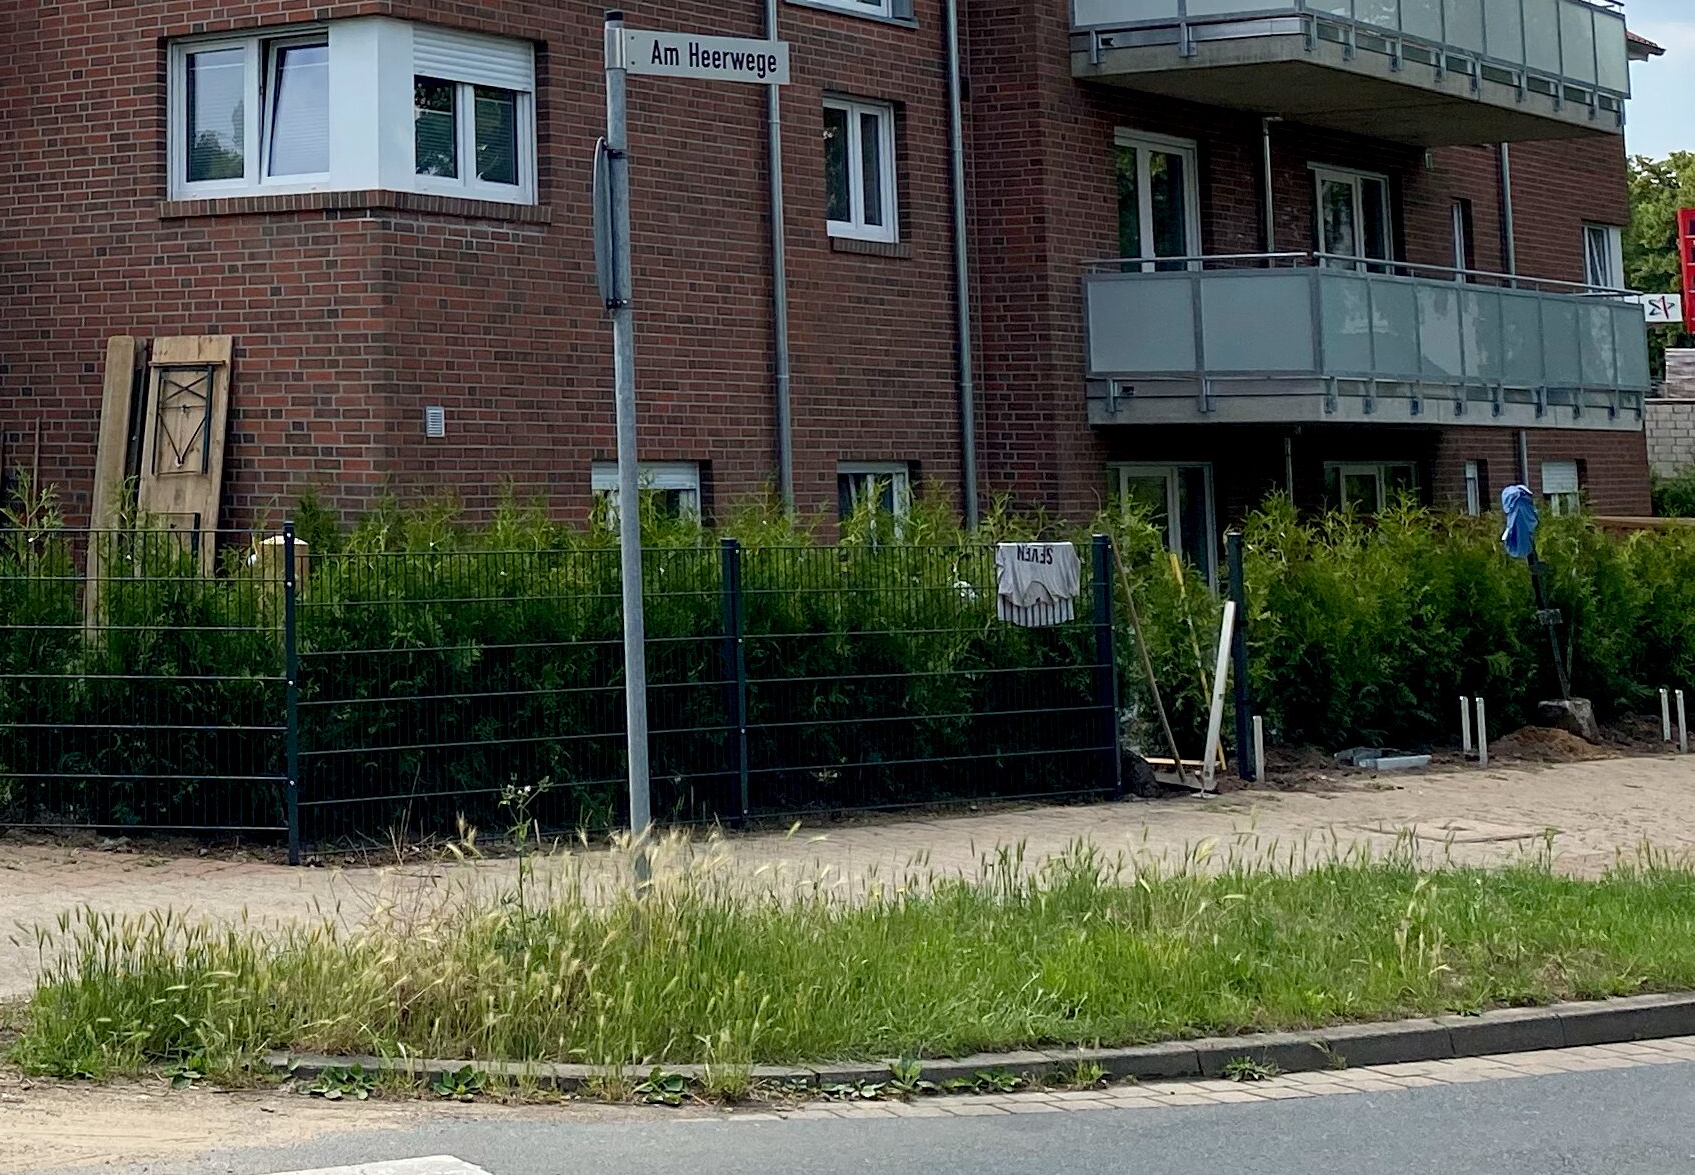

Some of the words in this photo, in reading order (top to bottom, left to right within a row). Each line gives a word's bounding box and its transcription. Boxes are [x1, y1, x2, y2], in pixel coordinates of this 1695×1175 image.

[651, 40, 679, 65] Am
[689, 42, 777, 78] Heerwege
[1017, 544, 1053, 564] SEVEN
